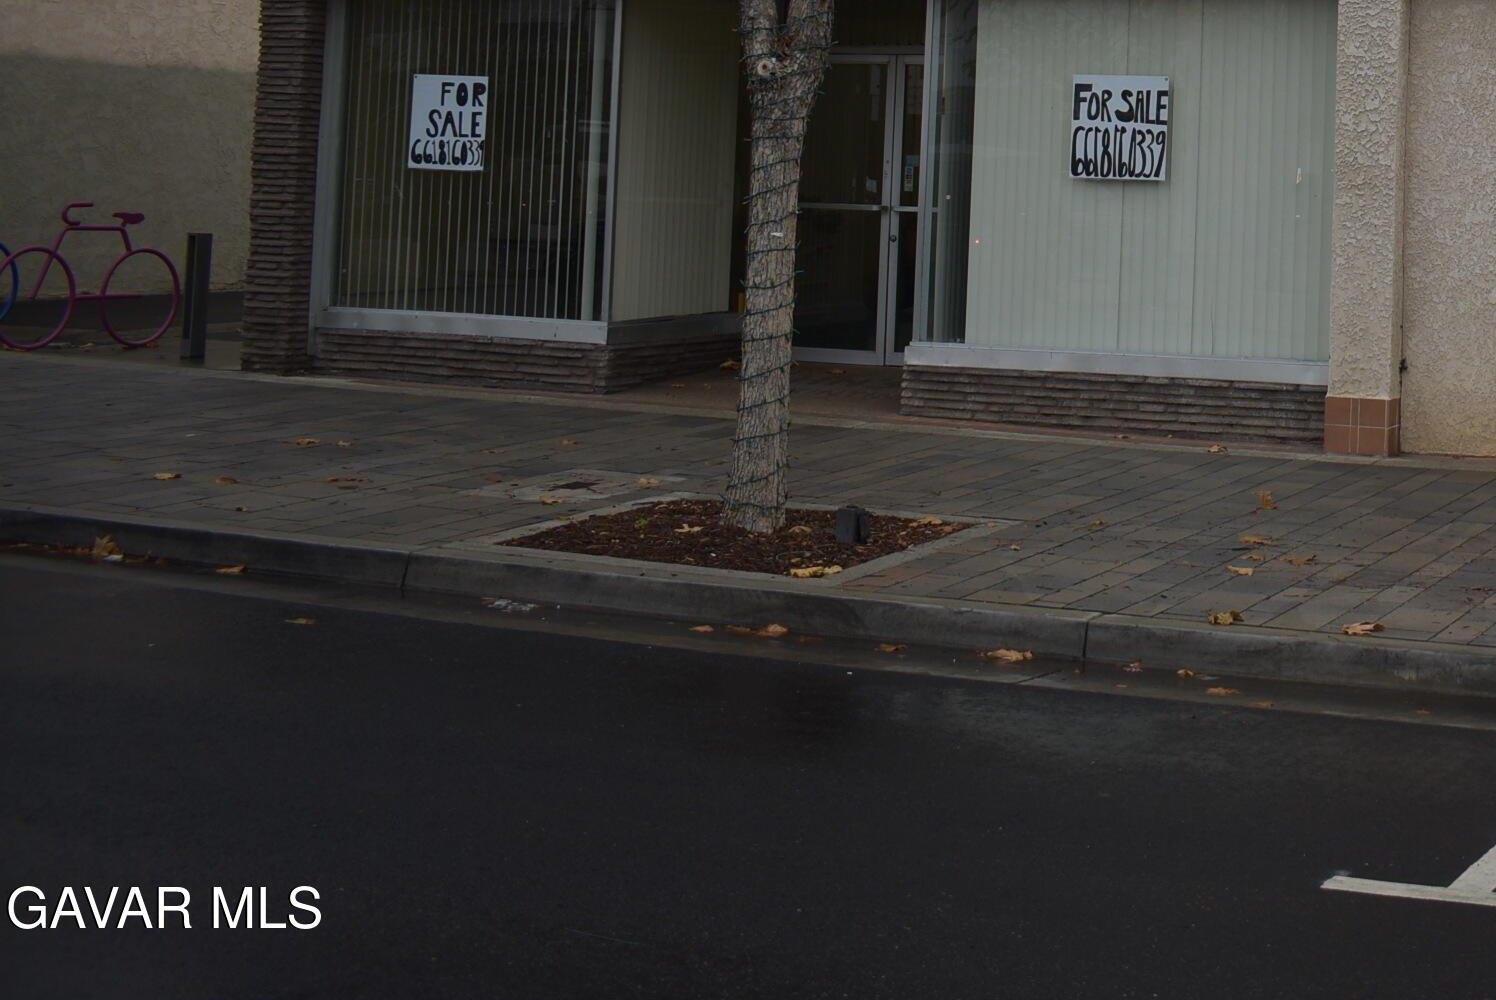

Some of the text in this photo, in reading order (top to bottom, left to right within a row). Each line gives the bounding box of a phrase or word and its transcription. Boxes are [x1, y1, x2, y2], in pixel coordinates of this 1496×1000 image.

[440, 82, 486, 107] FOR
[1073, 83, 1169, 126] FOR SALE
[425, 109, 483, 138] SALE
[410, 138, 486, 167] 6618160339
[1070, 124, 1167, 178] 6618160339
